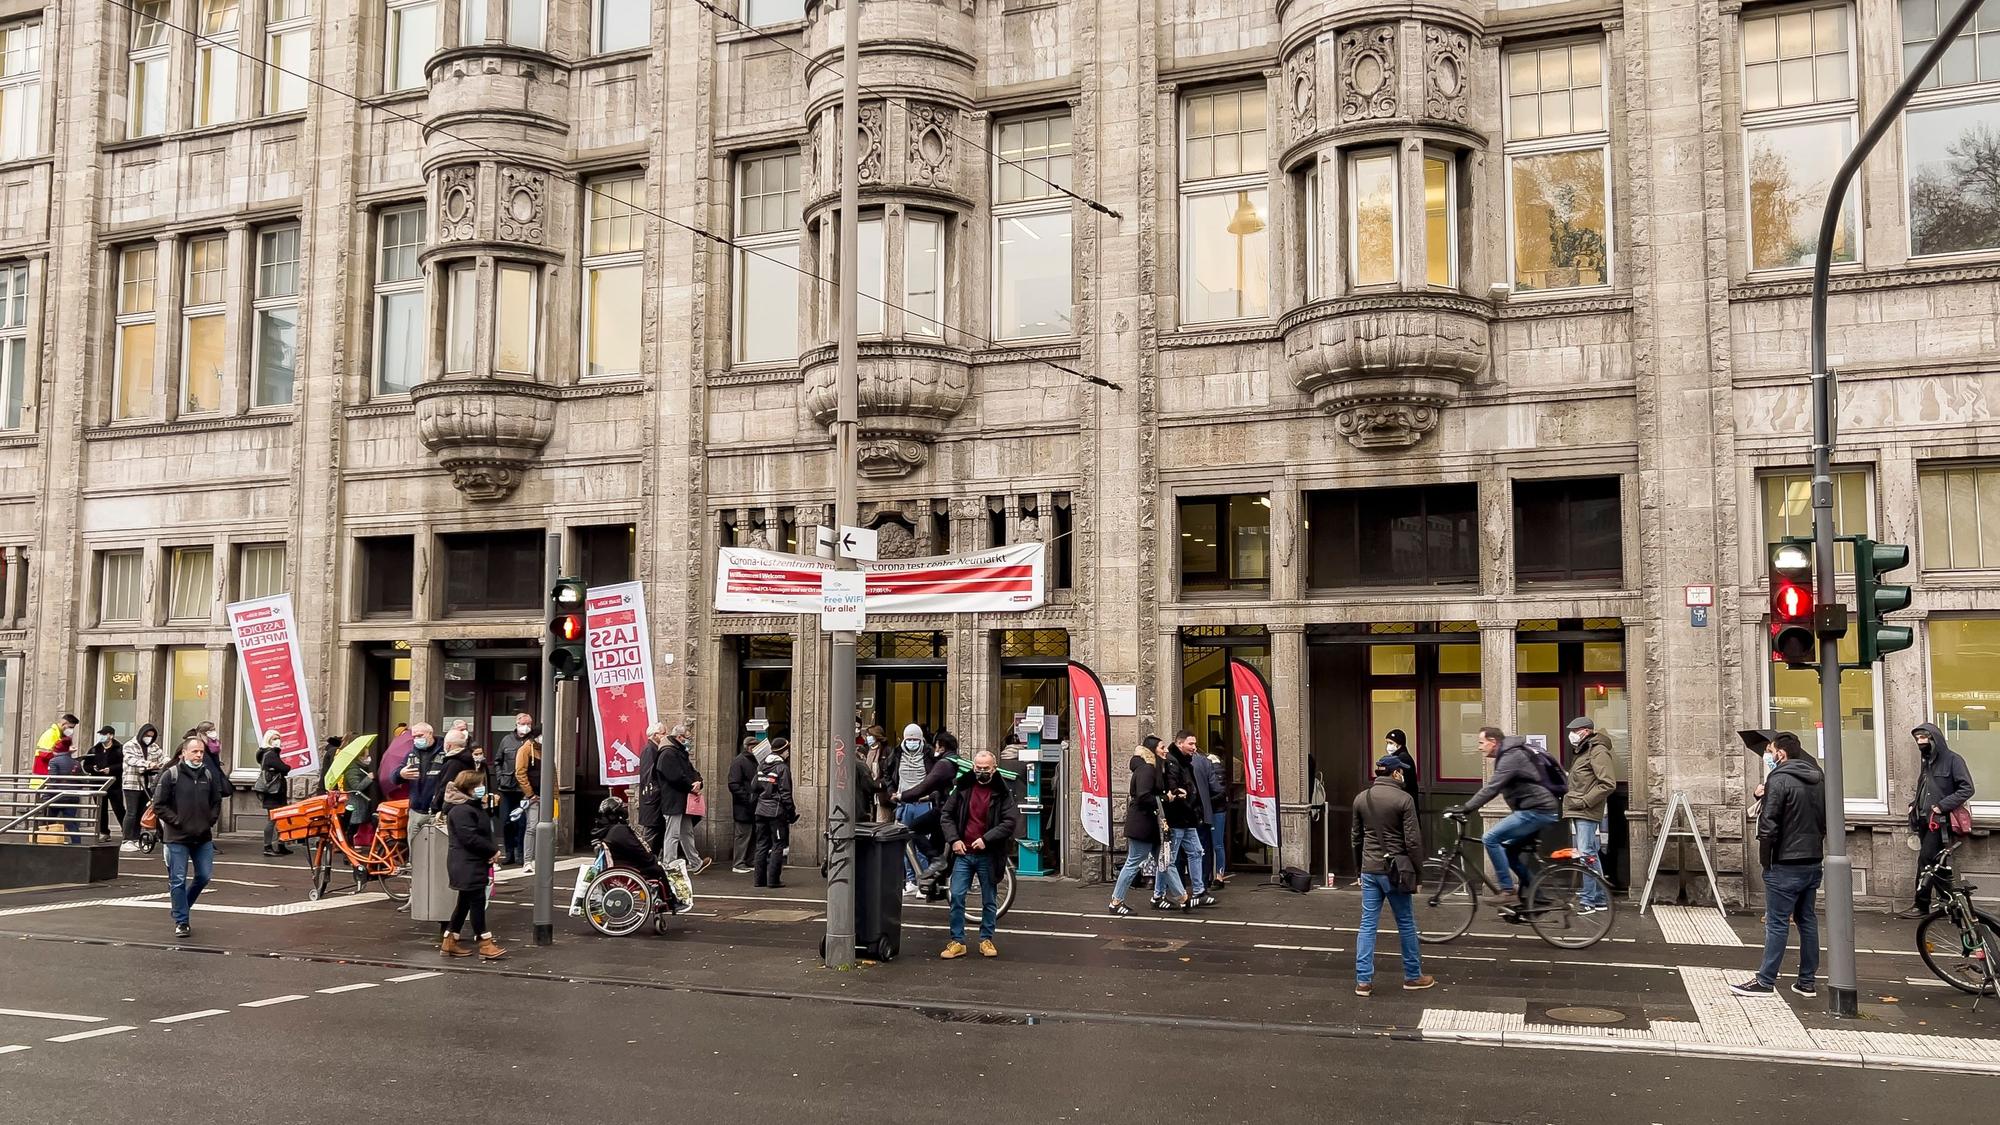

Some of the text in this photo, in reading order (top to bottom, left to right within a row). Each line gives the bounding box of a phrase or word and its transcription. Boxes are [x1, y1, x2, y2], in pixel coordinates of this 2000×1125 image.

[729, 555, 815, 569] Corona-Testzentrum
[872, 563, 905, 571] Corona
[956, 553, 1007, 565] Neumarkt
[824, 595, 864, 604] Free WiFi
[824, 604, 857, 613] für alle!
